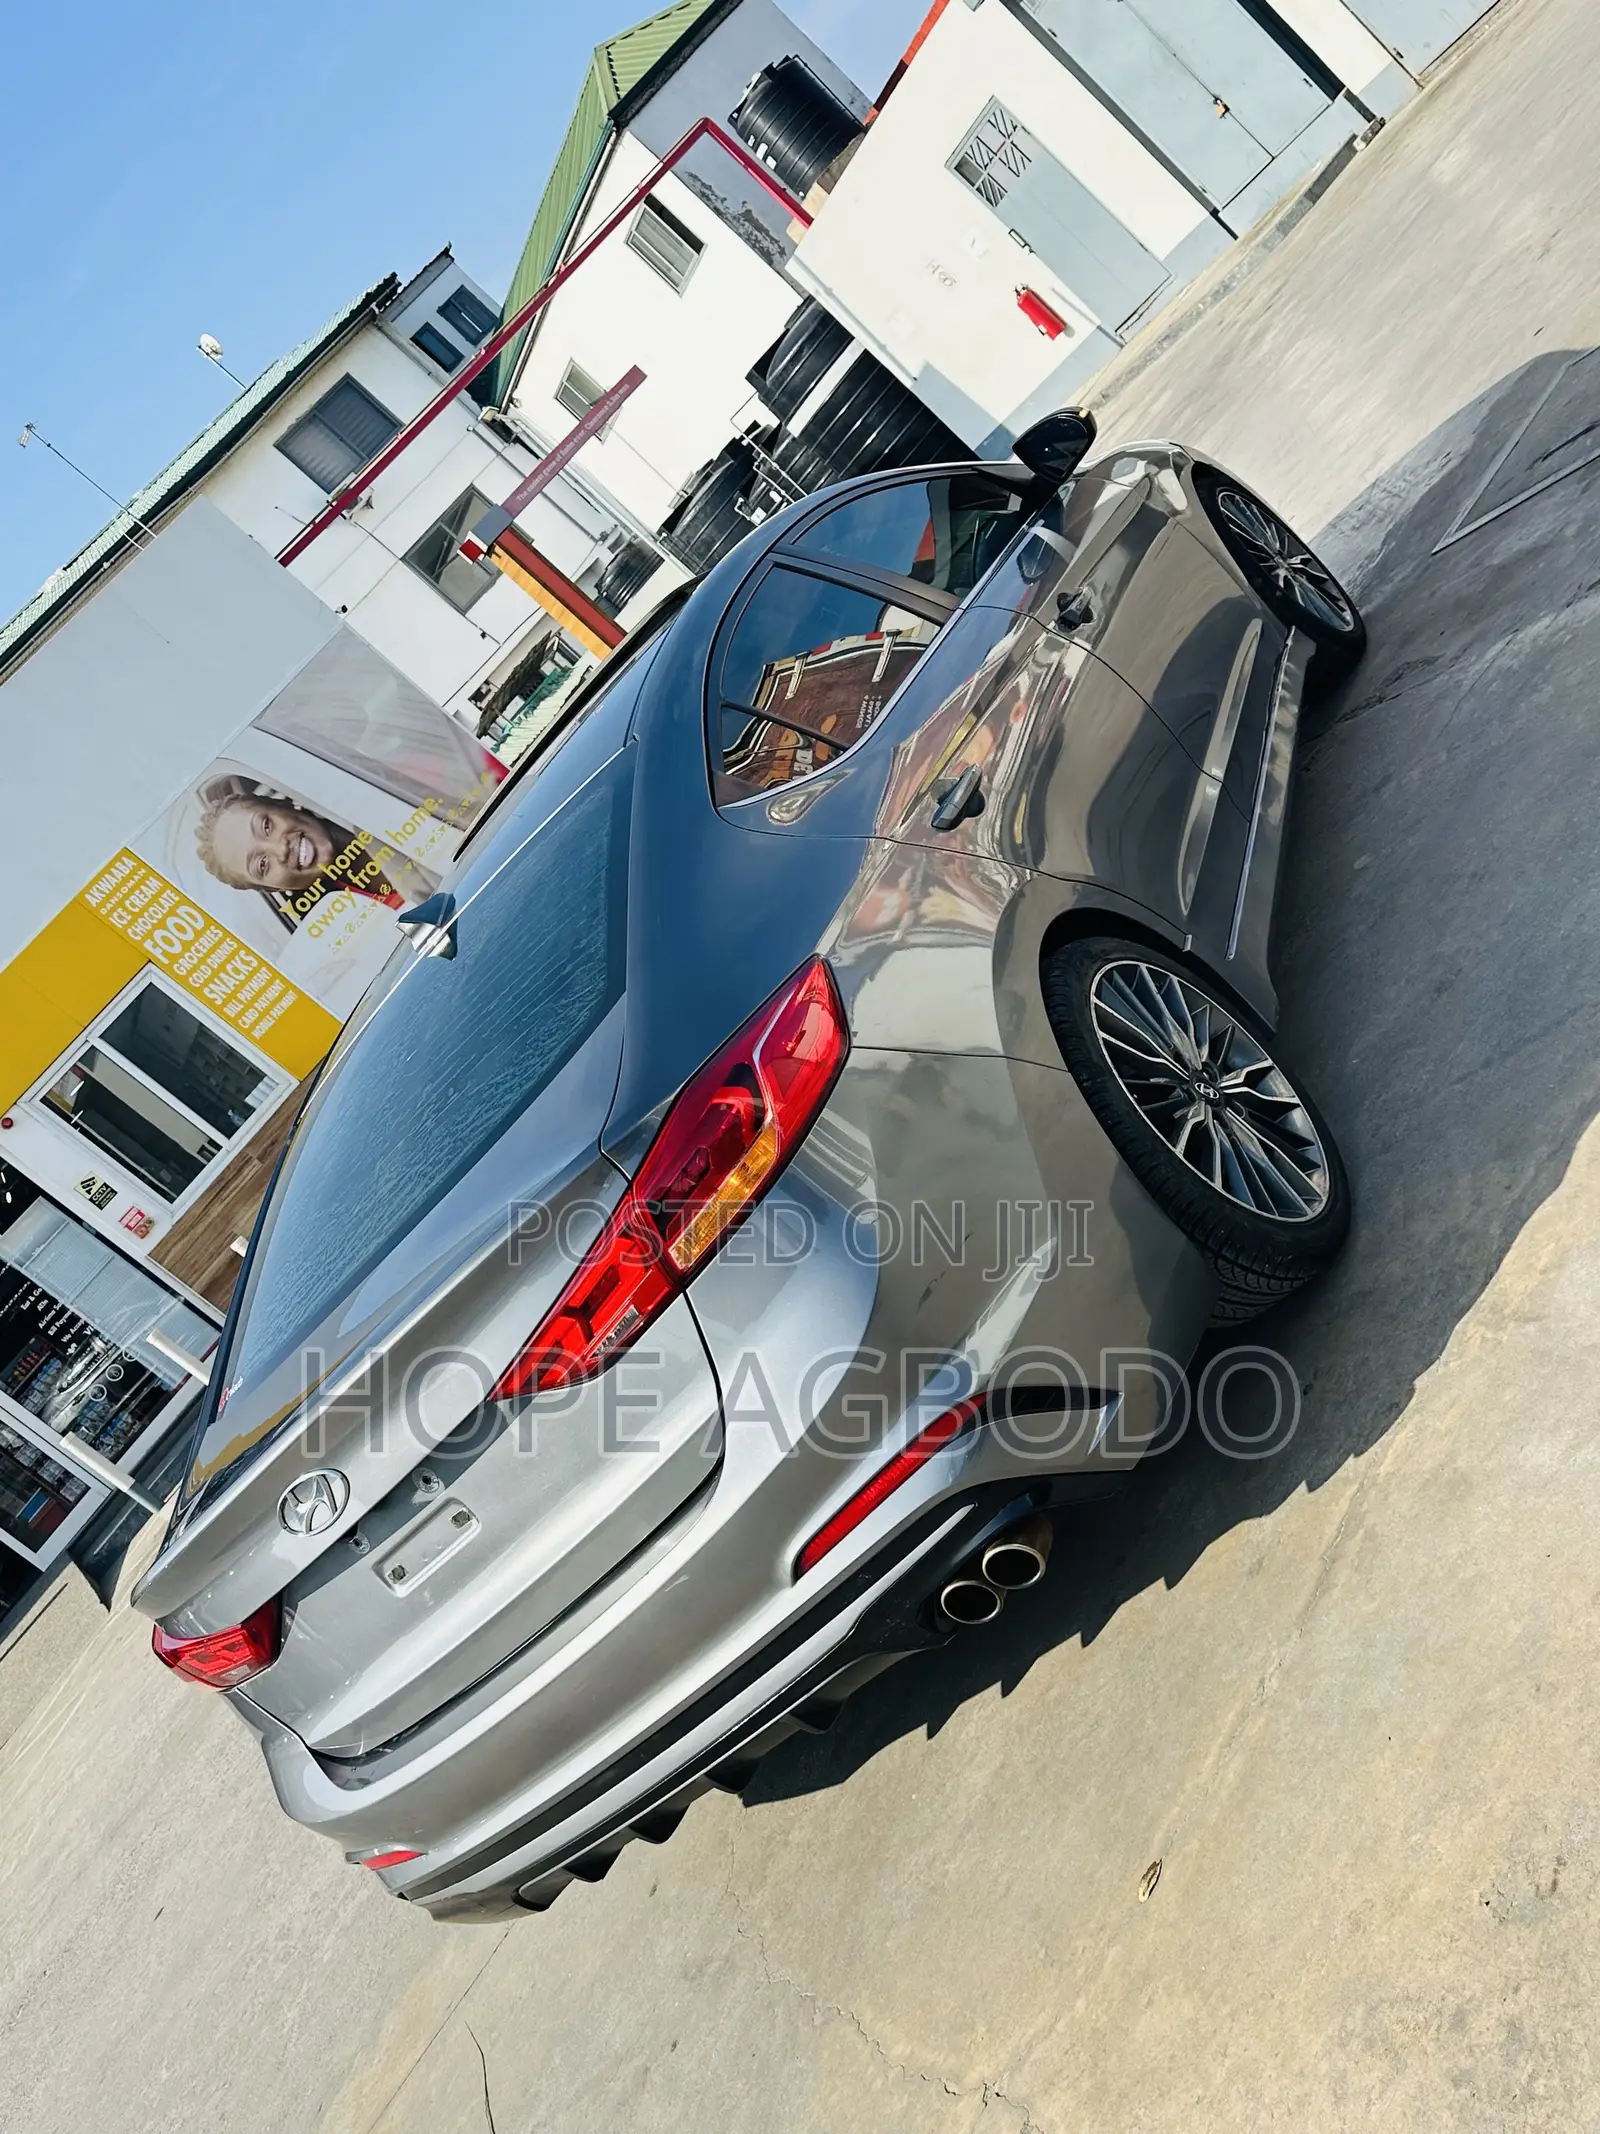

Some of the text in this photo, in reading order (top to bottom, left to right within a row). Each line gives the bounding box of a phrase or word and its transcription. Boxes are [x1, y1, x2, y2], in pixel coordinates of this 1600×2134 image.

[541, 459, 558, 476] game
[85, 856, 137, 907] AKWAABA
[100, 868, 146, 915] DANSOMAN
[280, 830, 373, 920] Your home
[308, 797, 444, 938] away from home.
[109, 877, 164, 928] ICE CREAM
[127, 889, 180, 940] CHOCOLATE
[143, 905, 204, 964] FOOD
[173, 925, 223, 976] GROCERIES
[188, 938, 238, 987] COLD DRINKS
[203, 950, 258, 1005] SNACKS
[223, 967, 272, 1018] BILL PAYMENT
[238, 979, 286, 1029] CARD PAYMENT
[252, 990, 298, 1039] MOBILE PAYMENT
[92, 1186, 106, 1200] CCTV
[37, 1308, 56, 1328] Airtime
[47, 1325, 57, 1336] Bill
[60, 1332, 72, 1343] We
